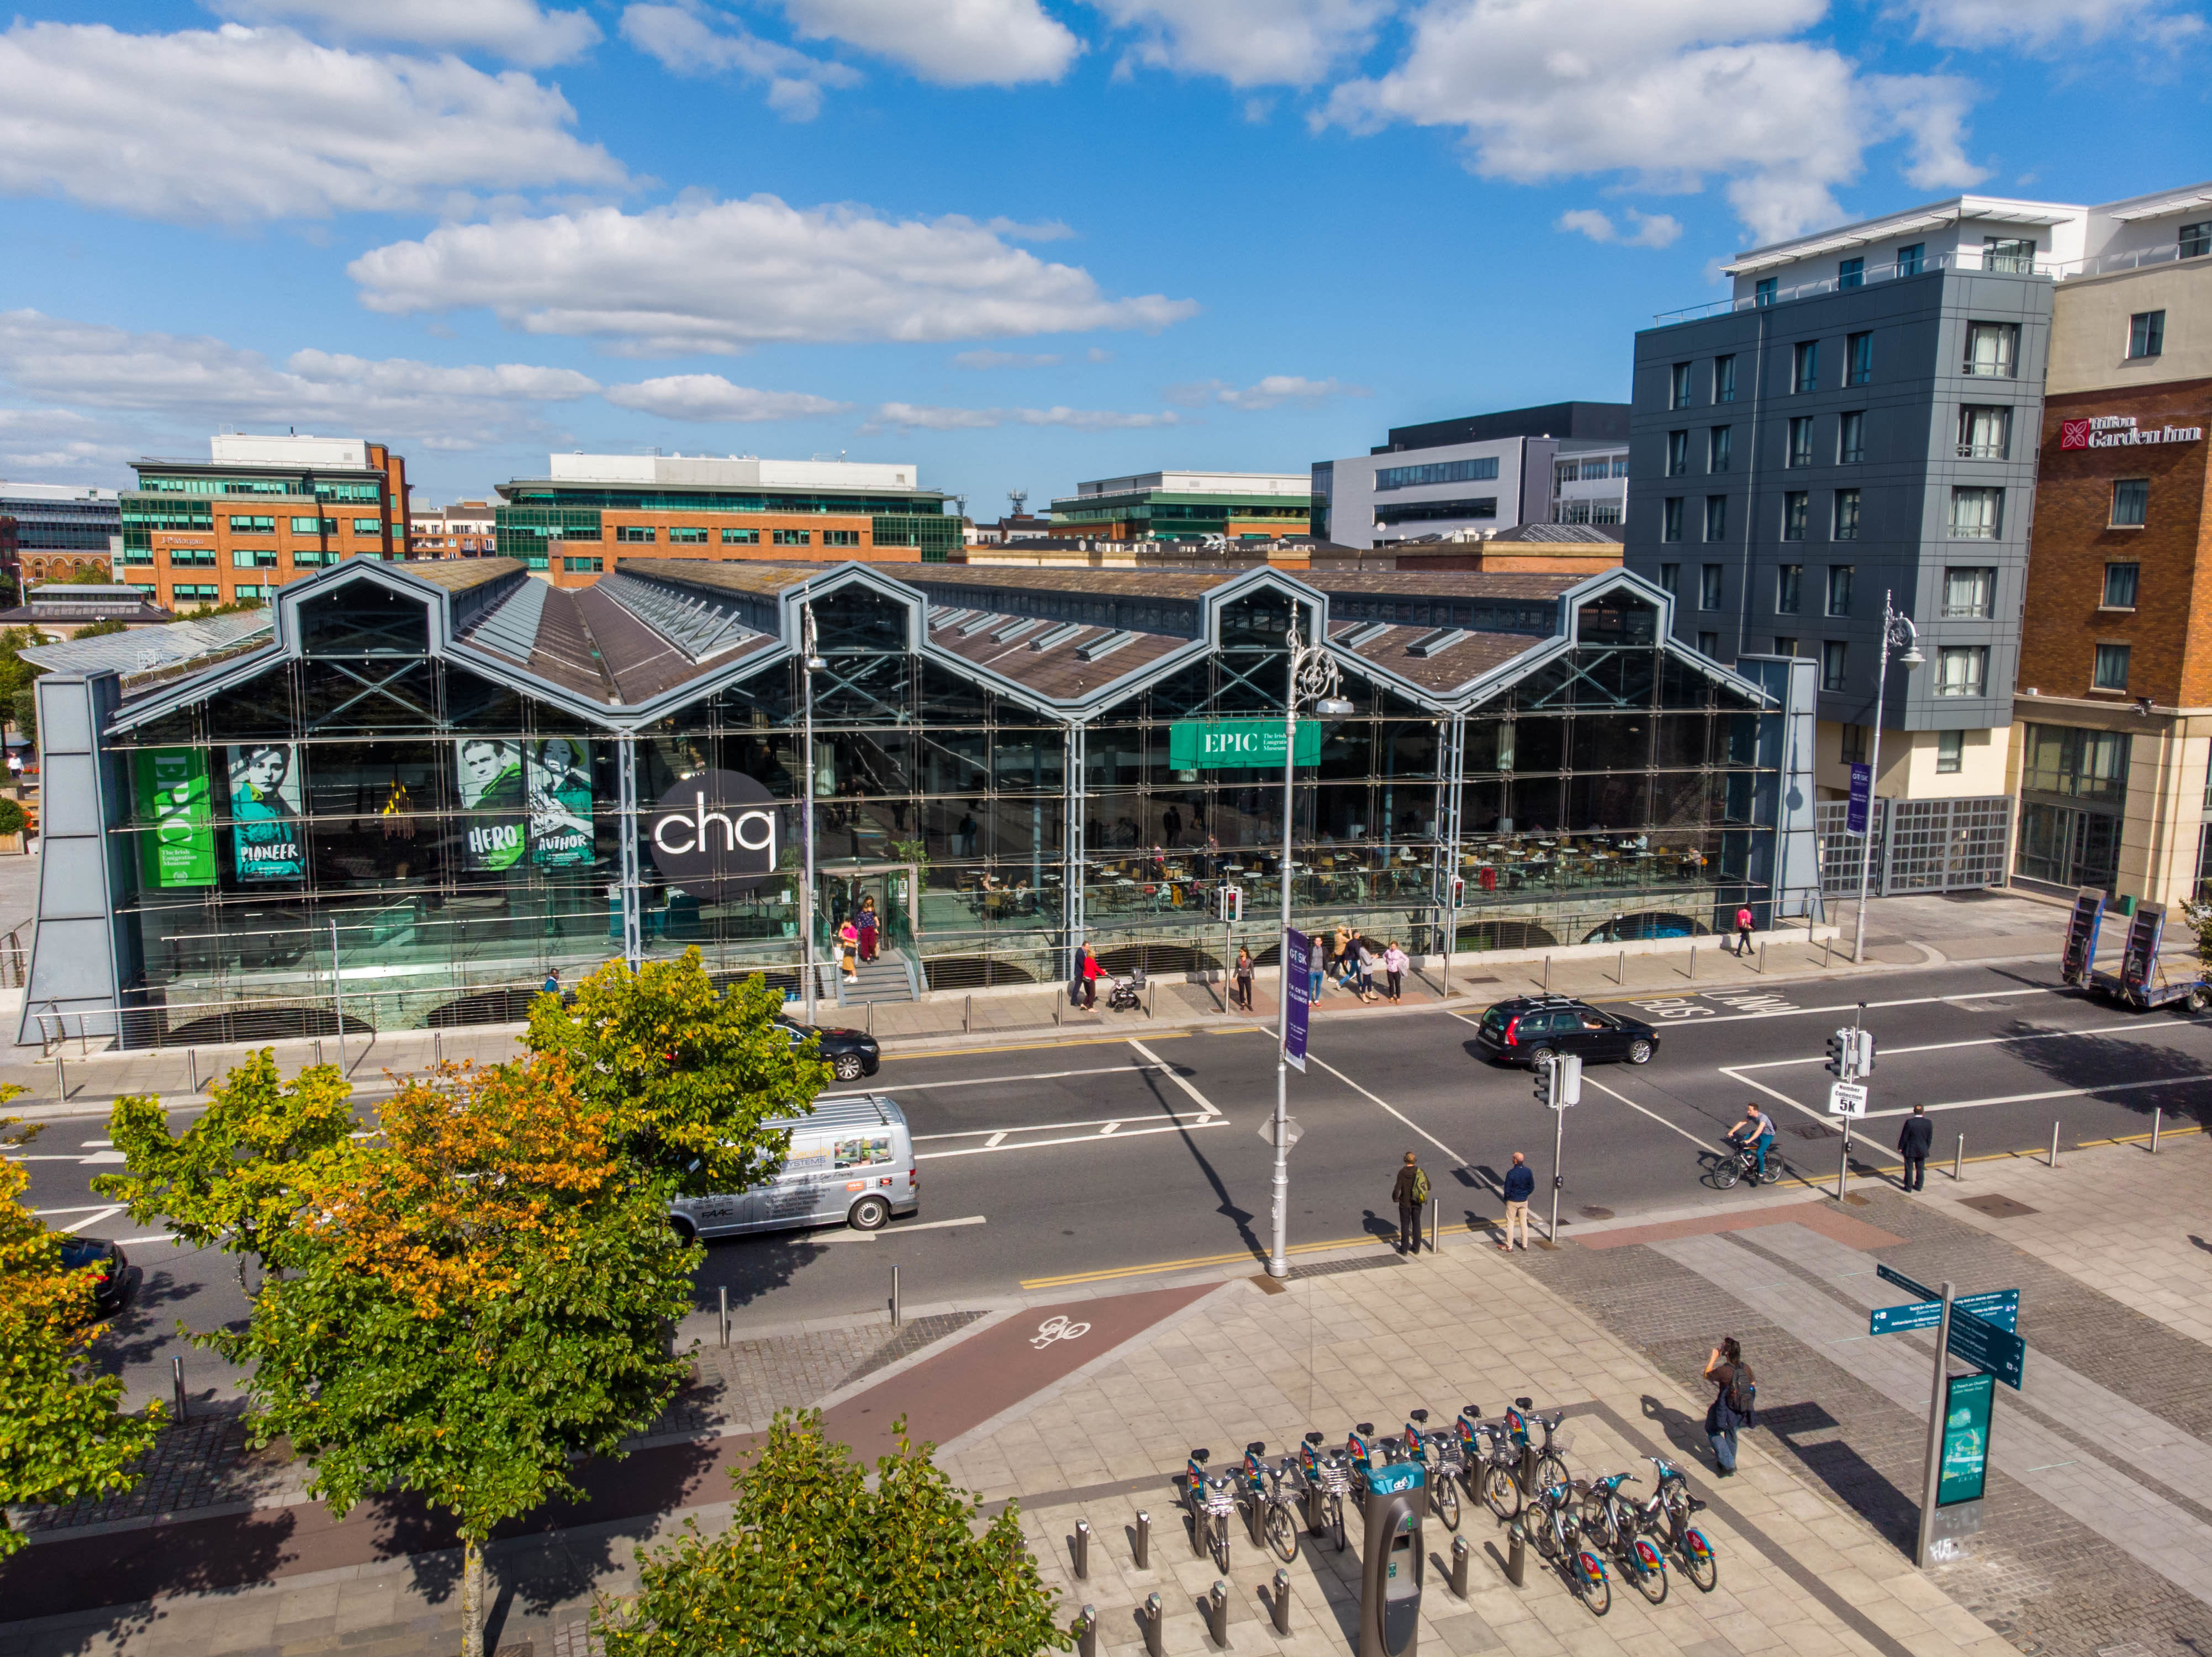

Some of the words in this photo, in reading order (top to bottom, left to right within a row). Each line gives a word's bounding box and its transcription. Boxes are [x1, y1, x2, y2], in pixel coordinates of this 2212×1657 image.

[2089, 416, 2137, 430] Hilton
[2088, 427, 2161, 448] Garden
[2162, 425, 2203, 442] Inn
[1205, 733, 1258, 752] EPIC
[469, 825, 517, 853] HERO
[654, 791, 775, 872] chq
[539, 834, 587, 851] AUTHOR
[241, 844, 298, 862] PIONEER
[1628, 998, 1715, 1018] BUS
[1835, 1090, 1863, 1100] Collection
[792, 1145, 831, 1159] Security
[782, 1157, 826, 1168] SYSTEMS
[702, 1209, 734, 1218] FAAC
